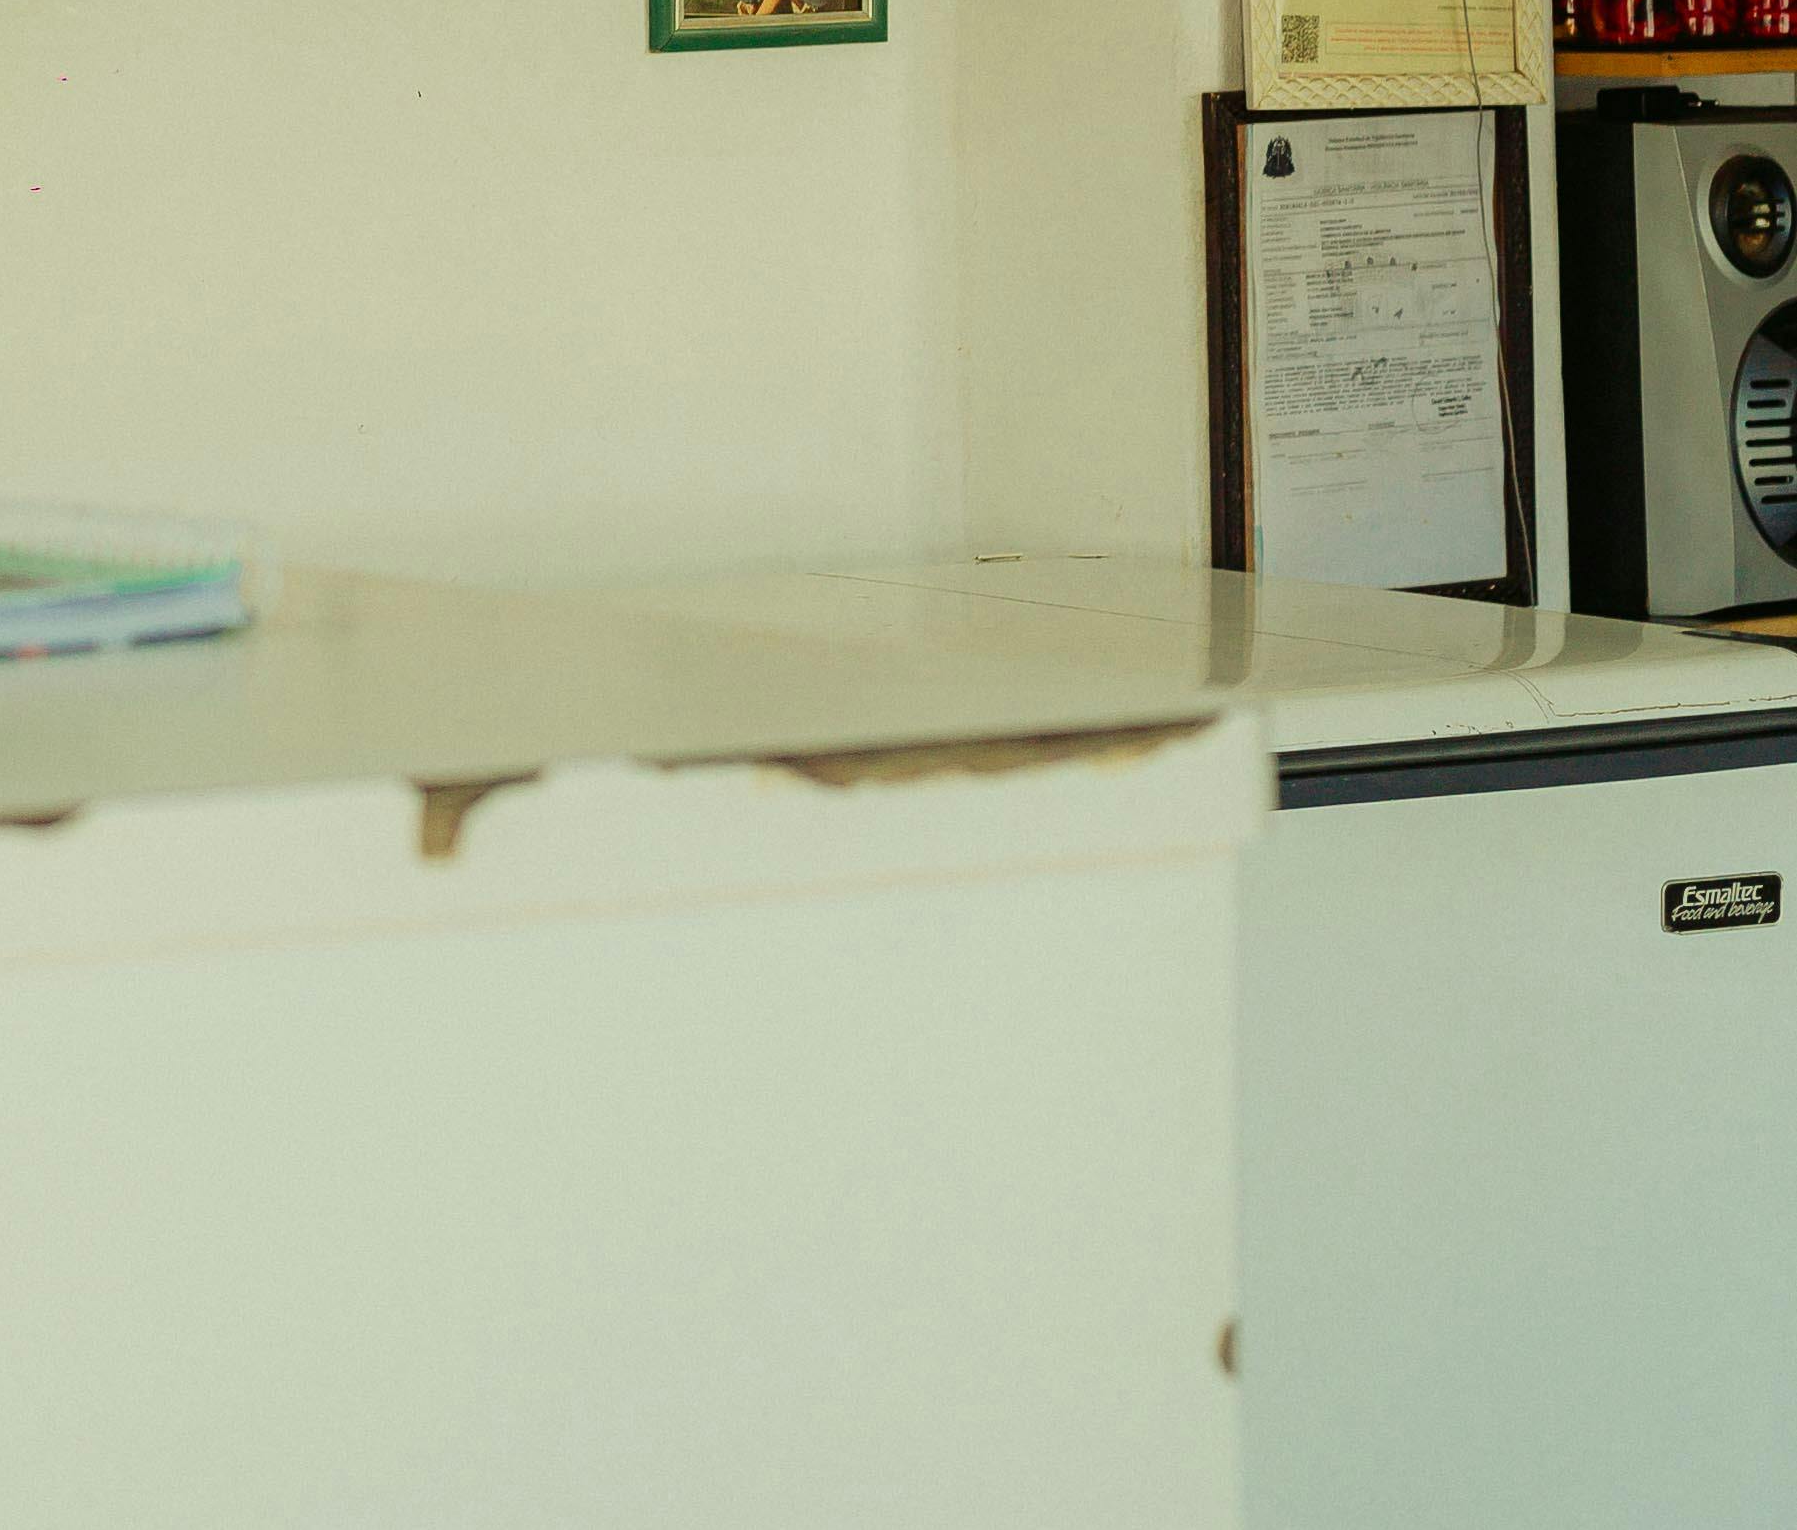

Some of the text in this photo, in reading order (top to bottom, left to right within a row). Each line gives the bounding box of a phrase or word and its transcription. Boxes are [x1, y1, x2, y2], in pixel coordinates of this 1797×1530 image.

[1682, 882, 1764, 907] Esmaltec
[1671, 901, 1775, 924] Food and beverage
